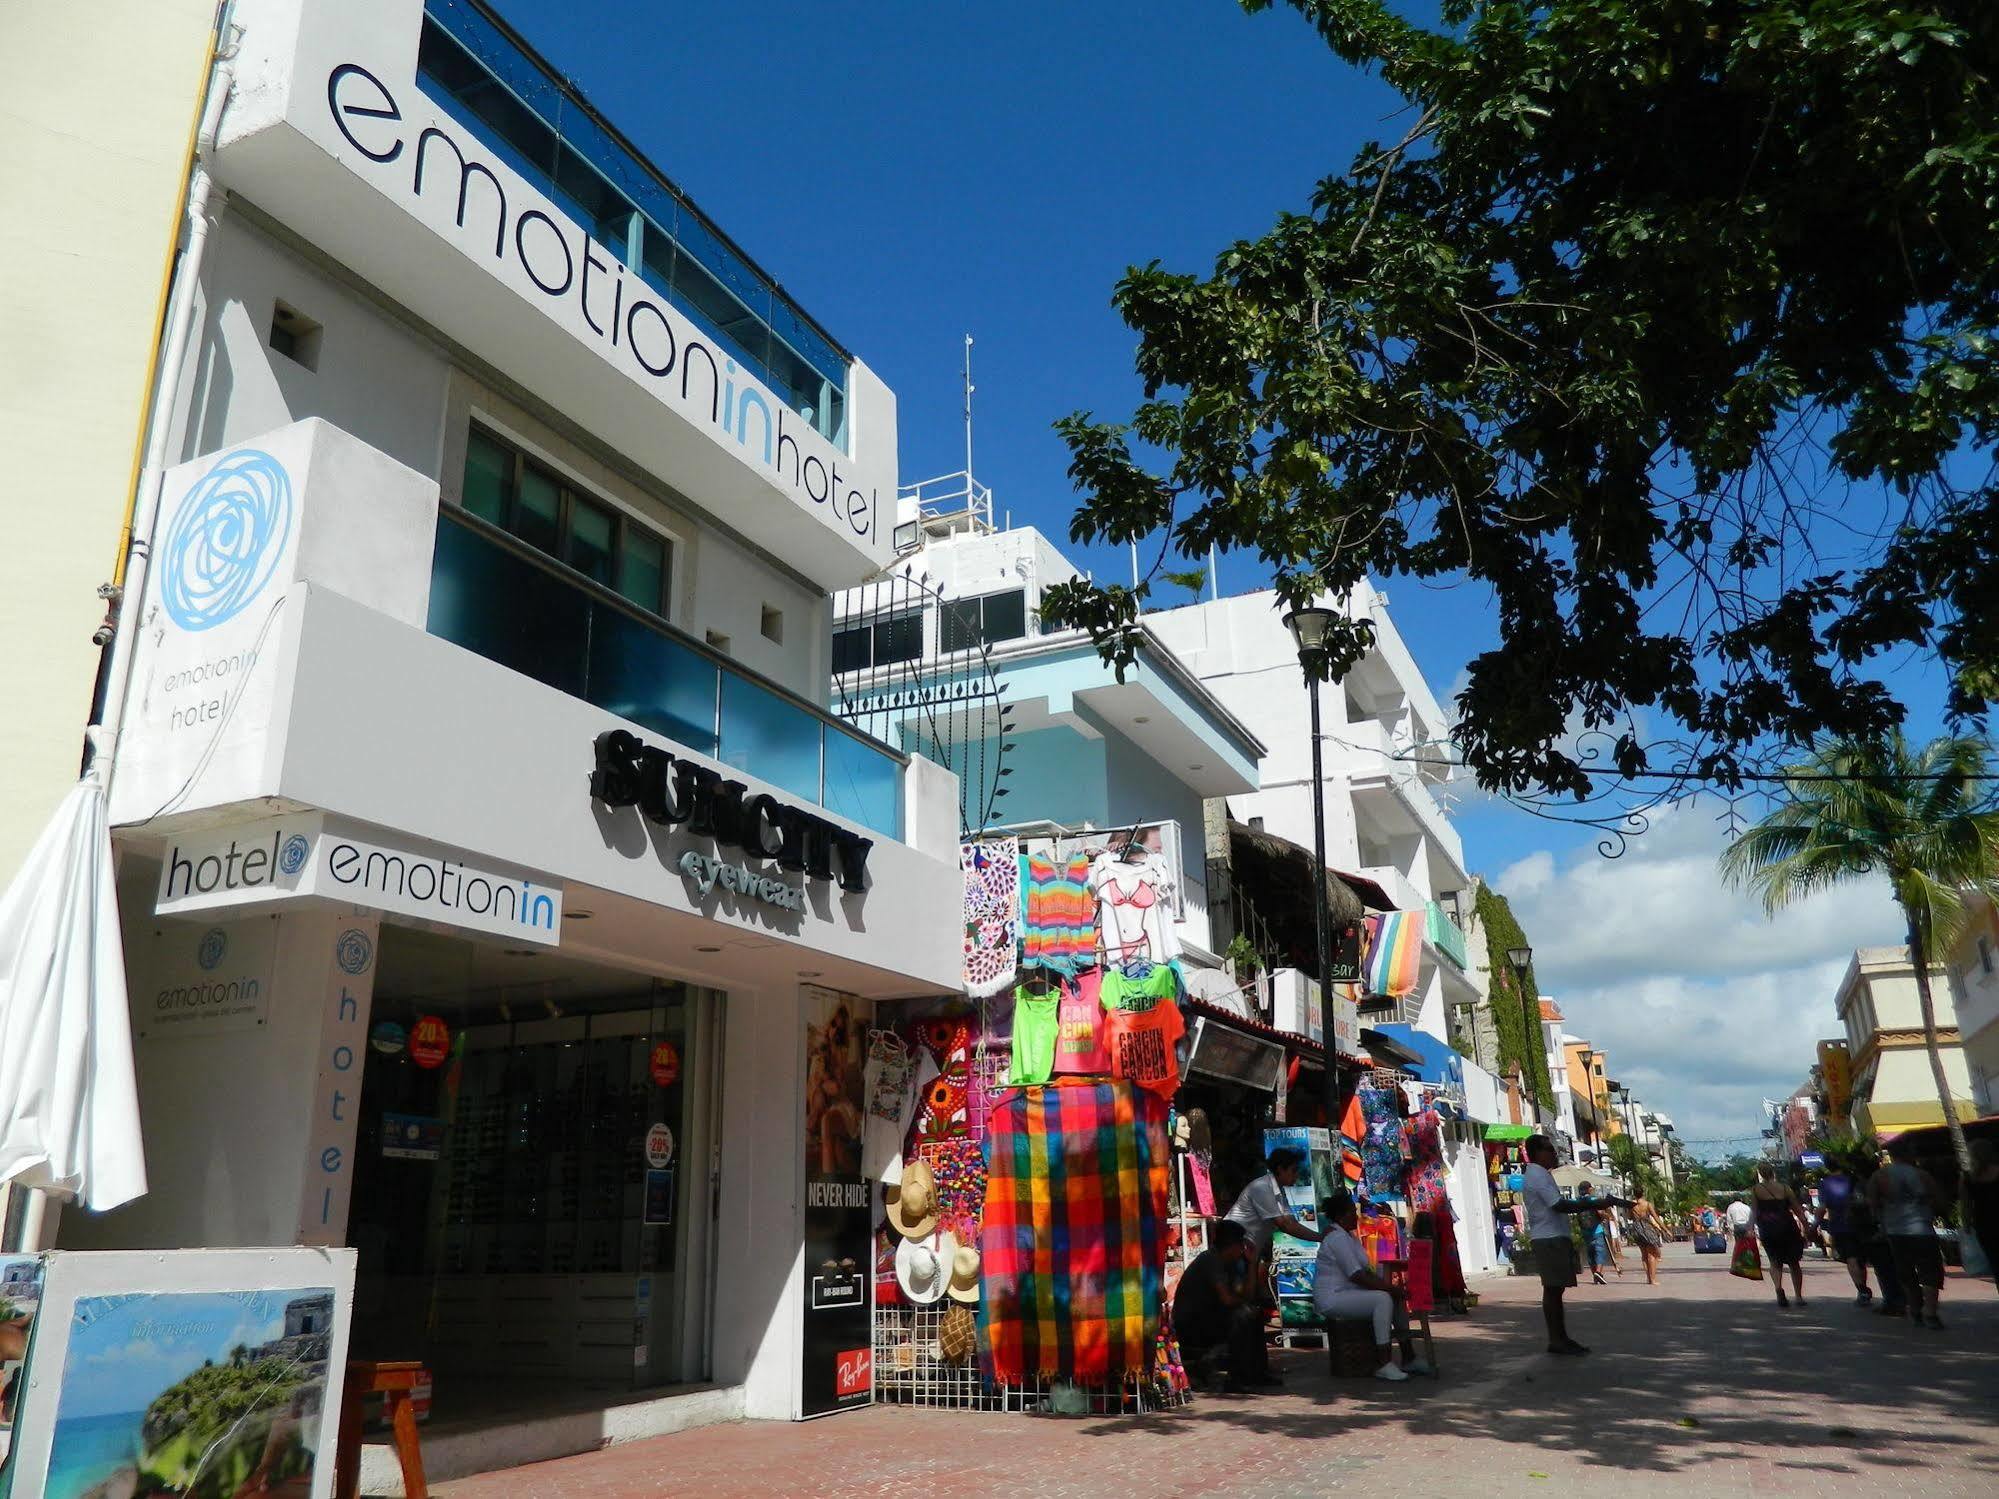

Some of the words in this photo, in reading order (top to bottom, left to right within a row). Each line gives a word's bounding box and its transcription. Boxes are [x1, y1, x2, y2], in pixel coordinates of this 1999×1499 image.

[170, 688, 228, 731] hotel
[166, 830, 281, 898] hotel
[680, 850, 804, 912] eyewear
[1282, 1128, 1306, 1139] TOURS
[808, 1182, 844, 1208] NEVER
[844, 1183, 869, 1208] HIDE
